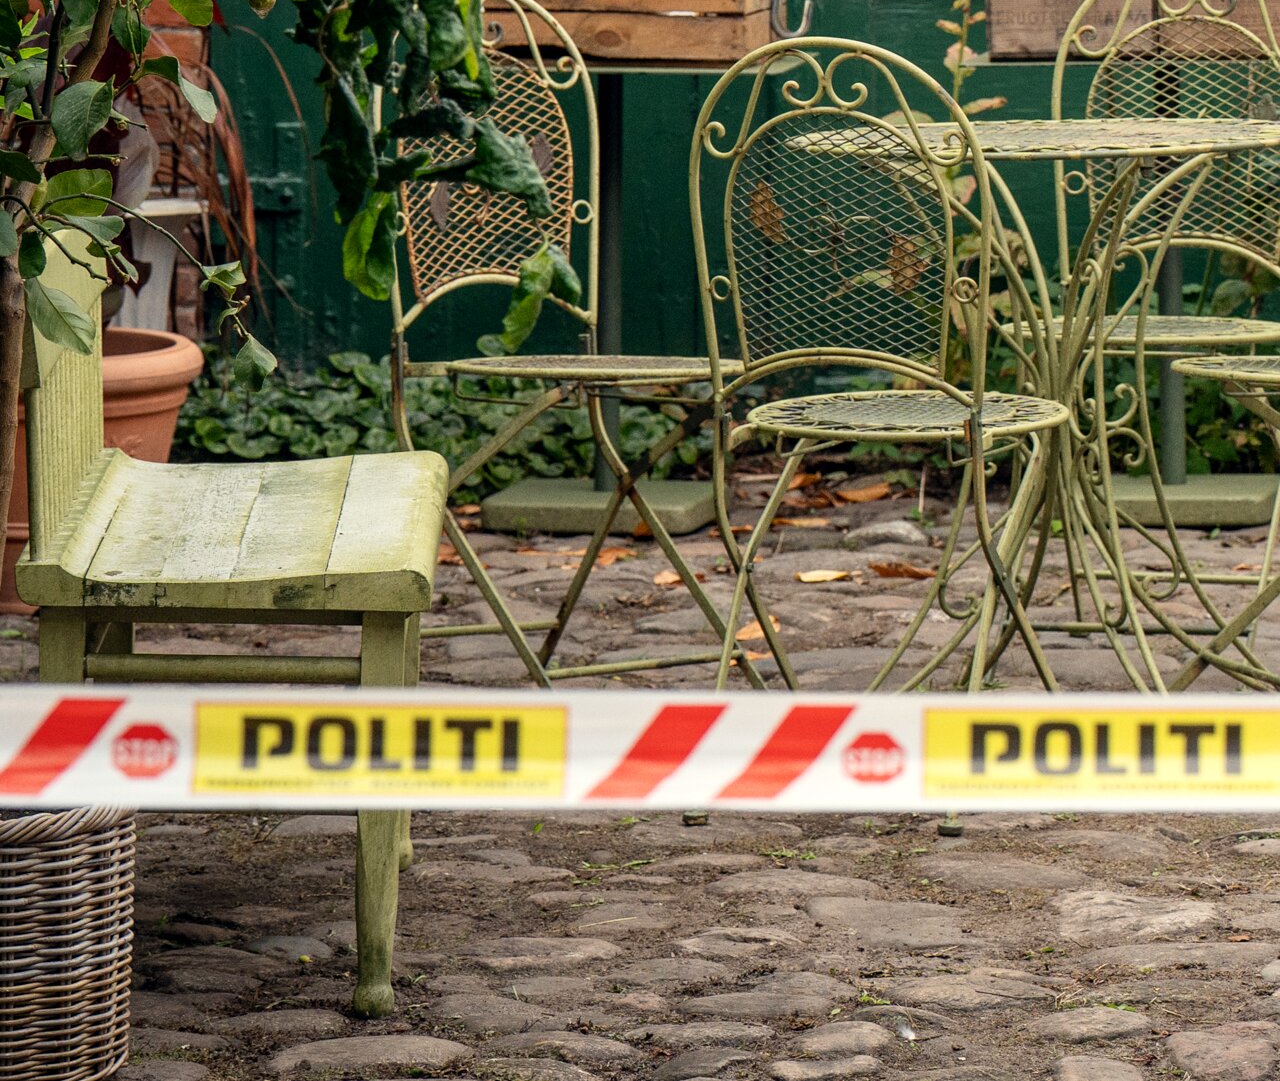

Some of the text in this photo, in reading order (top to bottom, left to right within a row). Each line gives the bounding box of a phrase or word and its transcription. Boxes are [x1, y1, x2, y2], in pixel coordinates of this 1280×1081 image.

[113, 738, 178, 766] STOP
[240, 715, 521, 773] POLITI
[843, 746, 905, 774] STOP
[969, 722, 1244, 776] POLITI
